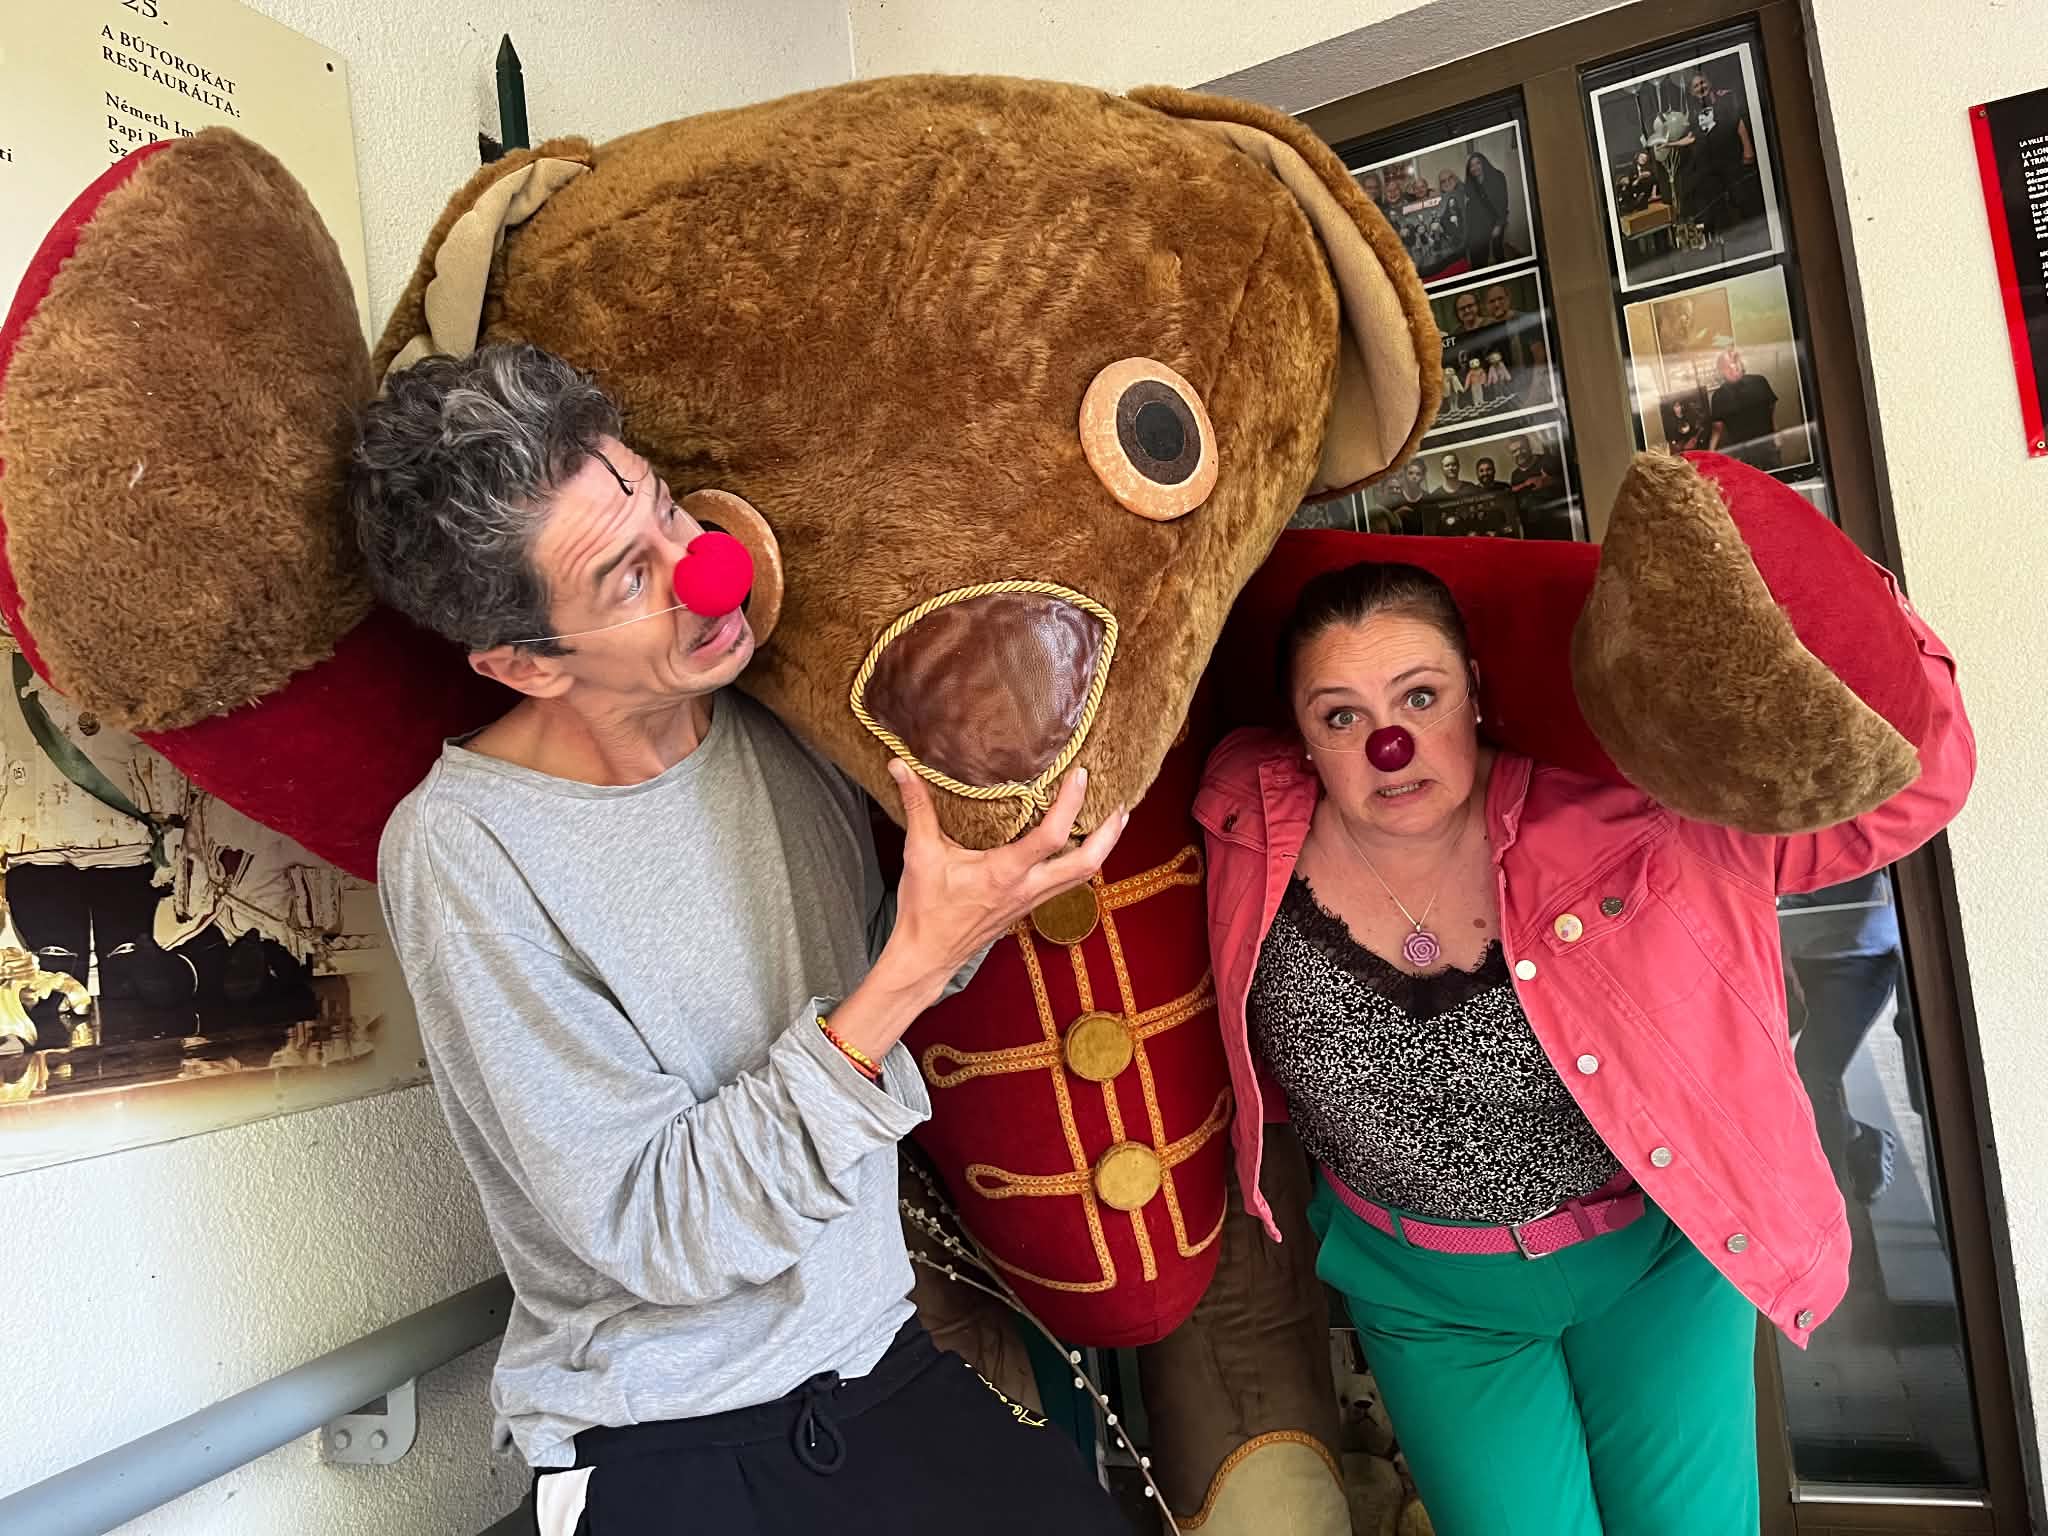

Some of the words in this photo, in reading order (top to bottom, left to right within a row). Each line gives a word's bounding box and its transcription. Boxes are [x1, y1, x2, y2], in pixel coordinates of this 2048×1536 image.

[101, 24, 114, 41] A
[120, 31, 236, 95] BÚTOROKAT
[102, 45, 241, 119] RESTAURÁLTA:
[105, 91, 170, 132] Németh
[107, 114, 144, 143] Papi
[2021, 150, 2032, 159] LA
